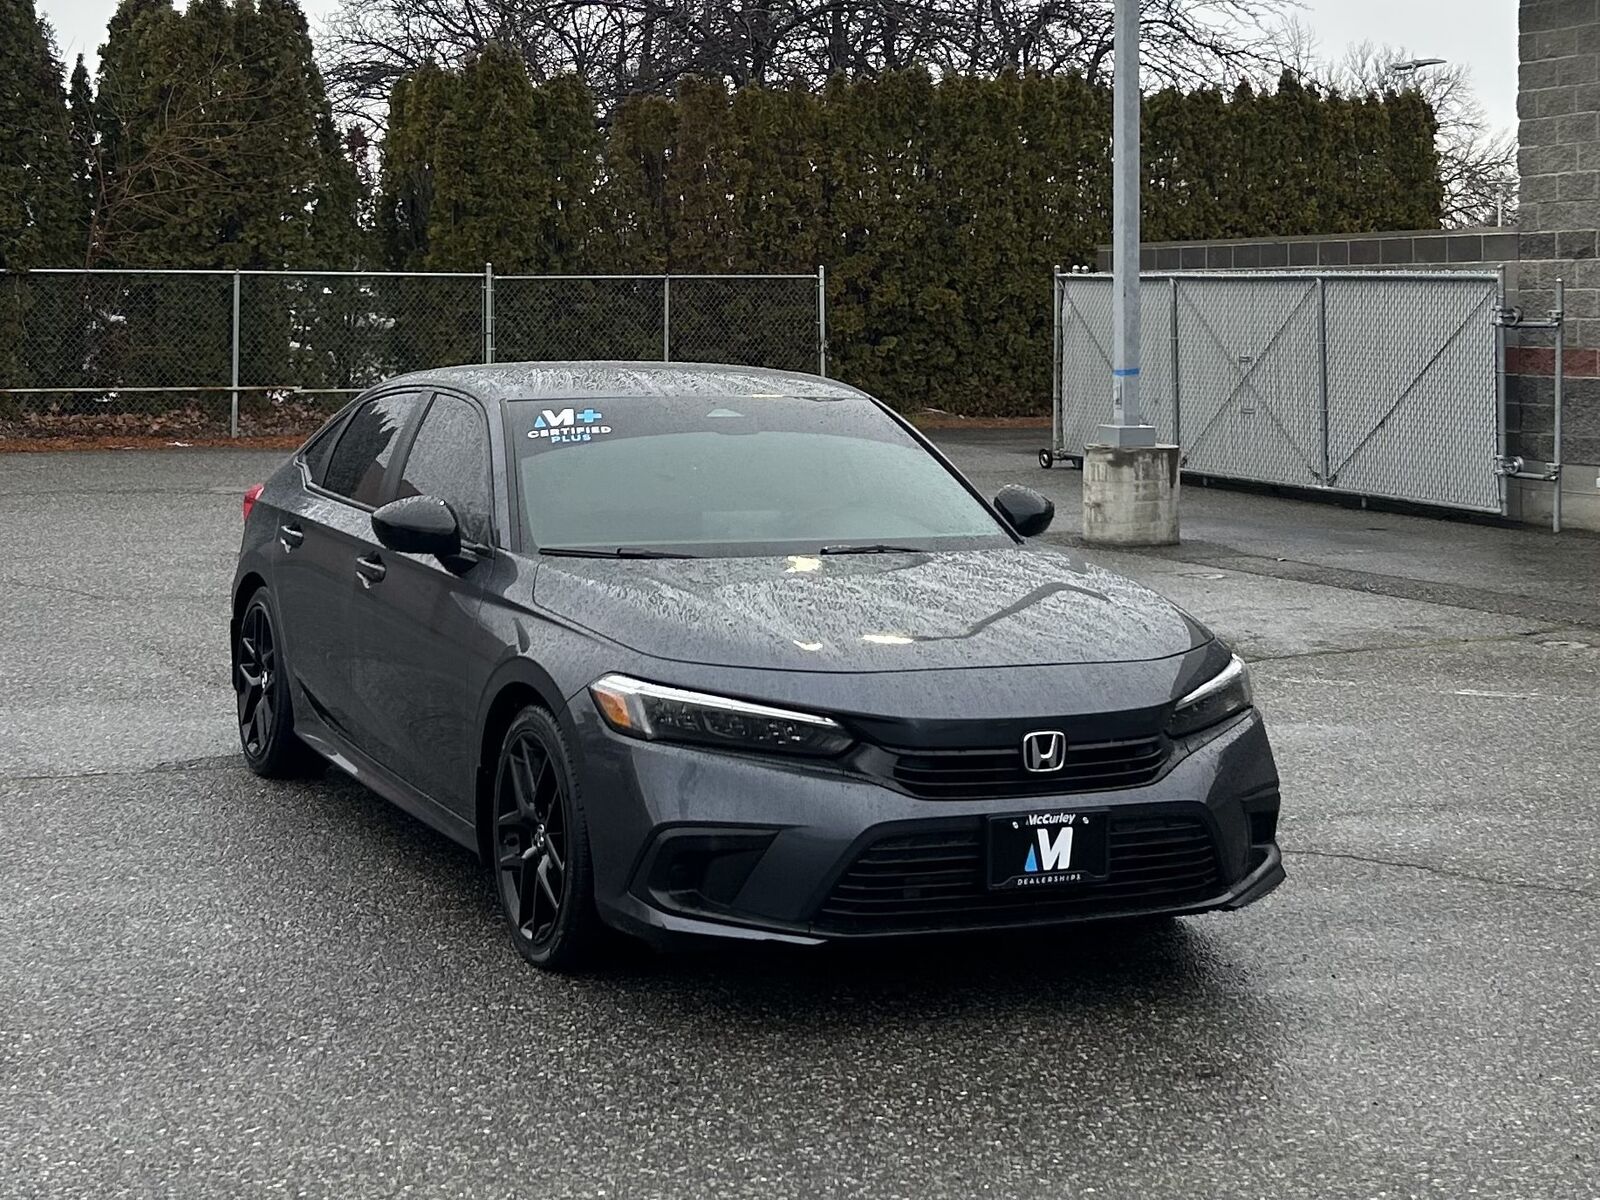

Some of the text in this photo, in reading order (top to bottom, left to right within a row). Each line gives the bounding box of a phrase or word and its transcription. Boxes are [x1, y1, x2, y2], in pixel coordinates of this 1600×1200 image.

[527, 426, 612, 438] CERTIFIED
[551, 433, 592, 443] PLUS
[1025, 812, 1076, 826] McCurley
[1017, 873, 1081, 886] DEALERSHIPS
